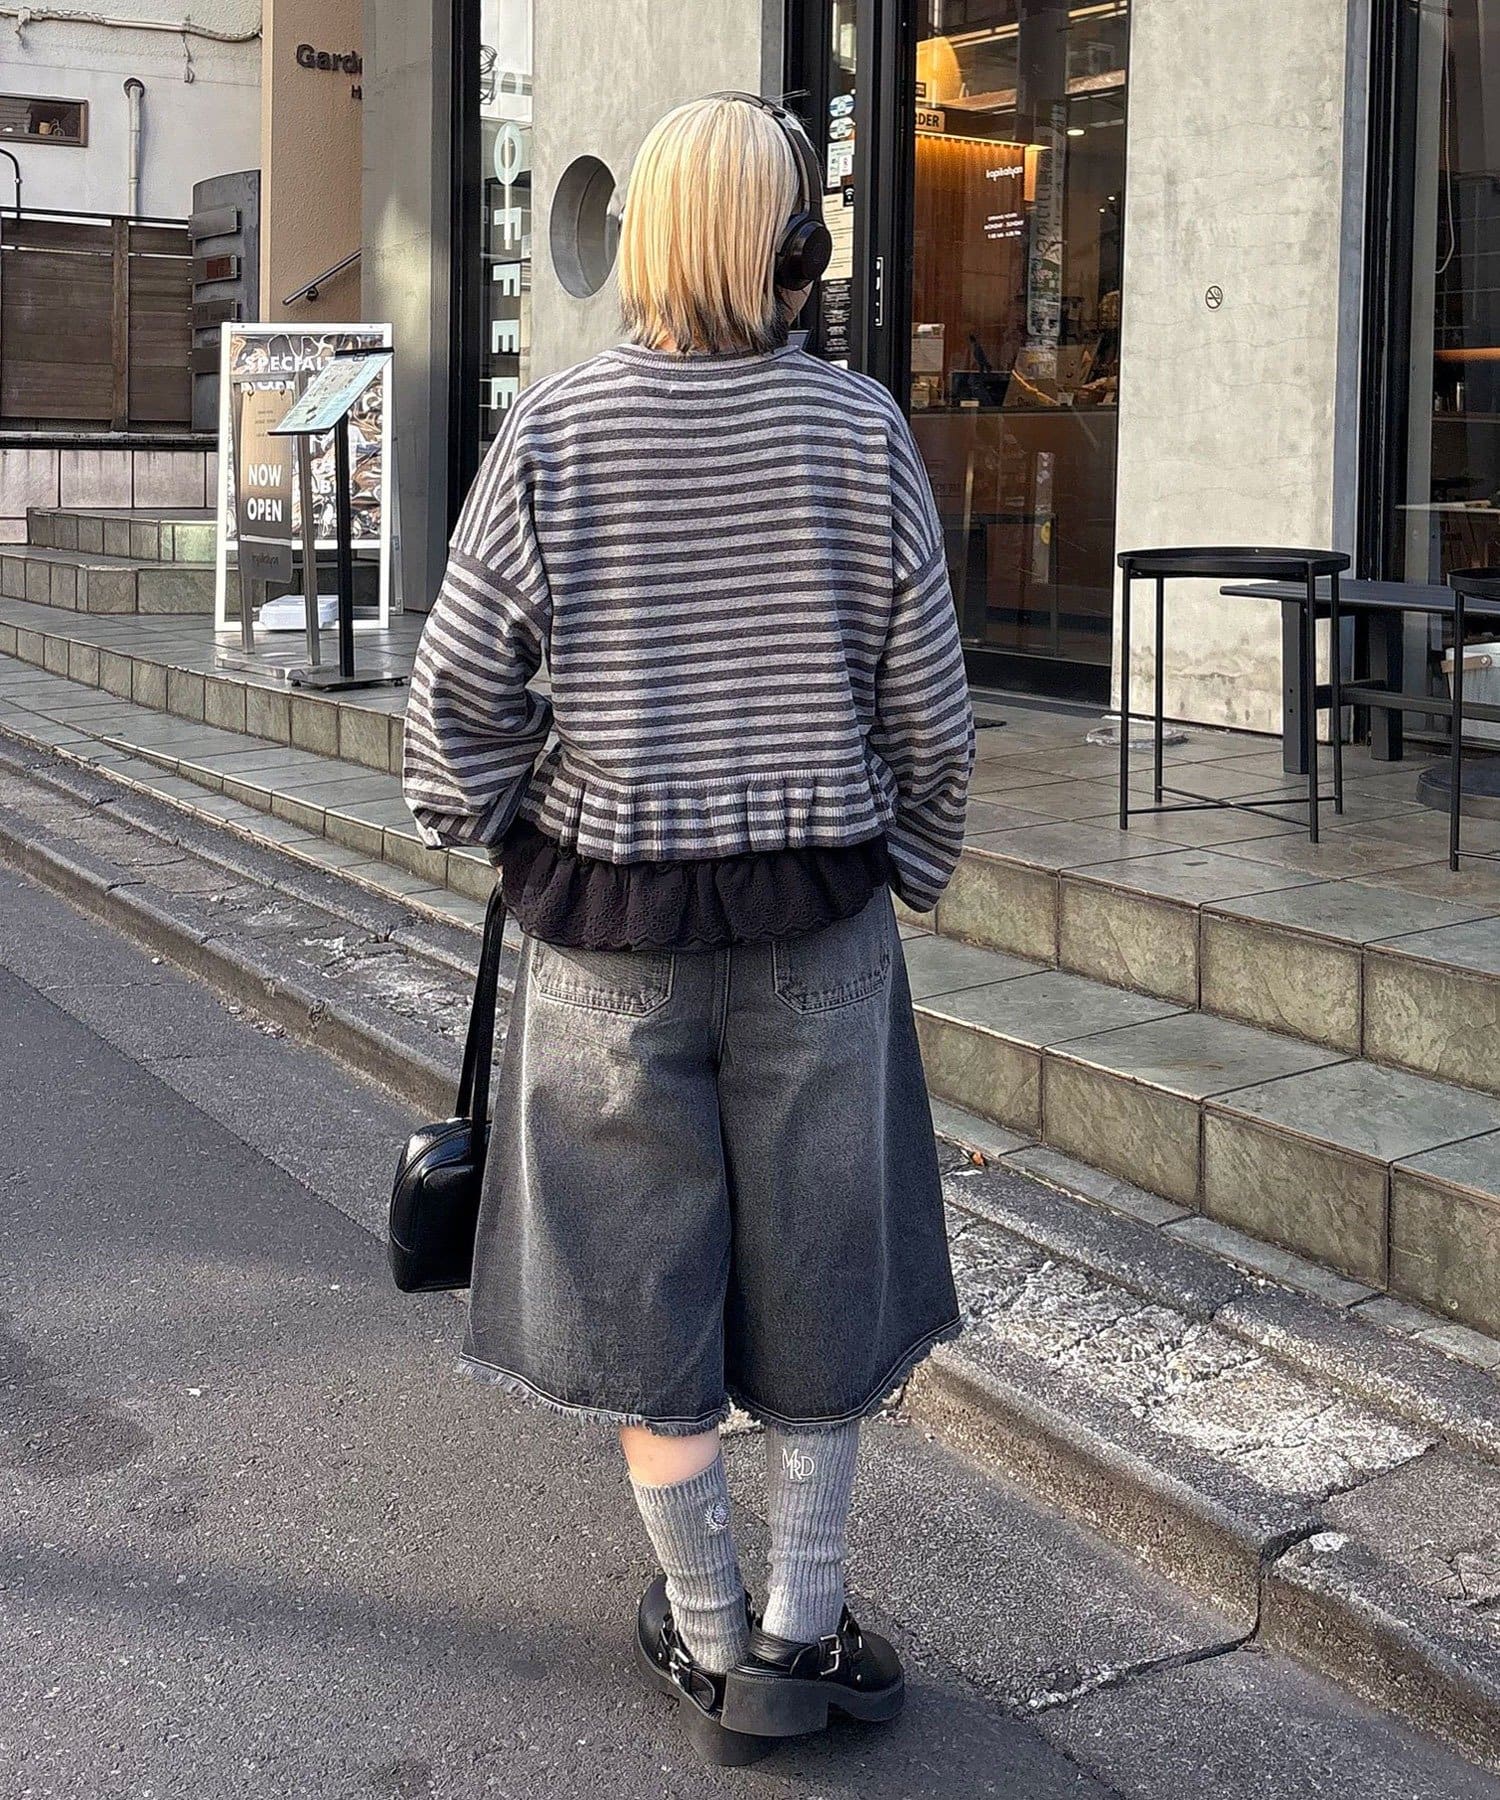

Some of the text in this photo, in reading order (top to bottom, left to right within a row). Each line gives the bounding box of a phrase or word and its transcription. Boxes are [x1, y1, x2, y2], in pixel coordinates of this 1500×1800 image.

[296, 43, 363, 75] Gard
[915, 112, 940, 128] DER
[248, 463, 283, 488] NOW
[247, 497, 283, 523] OPEN
